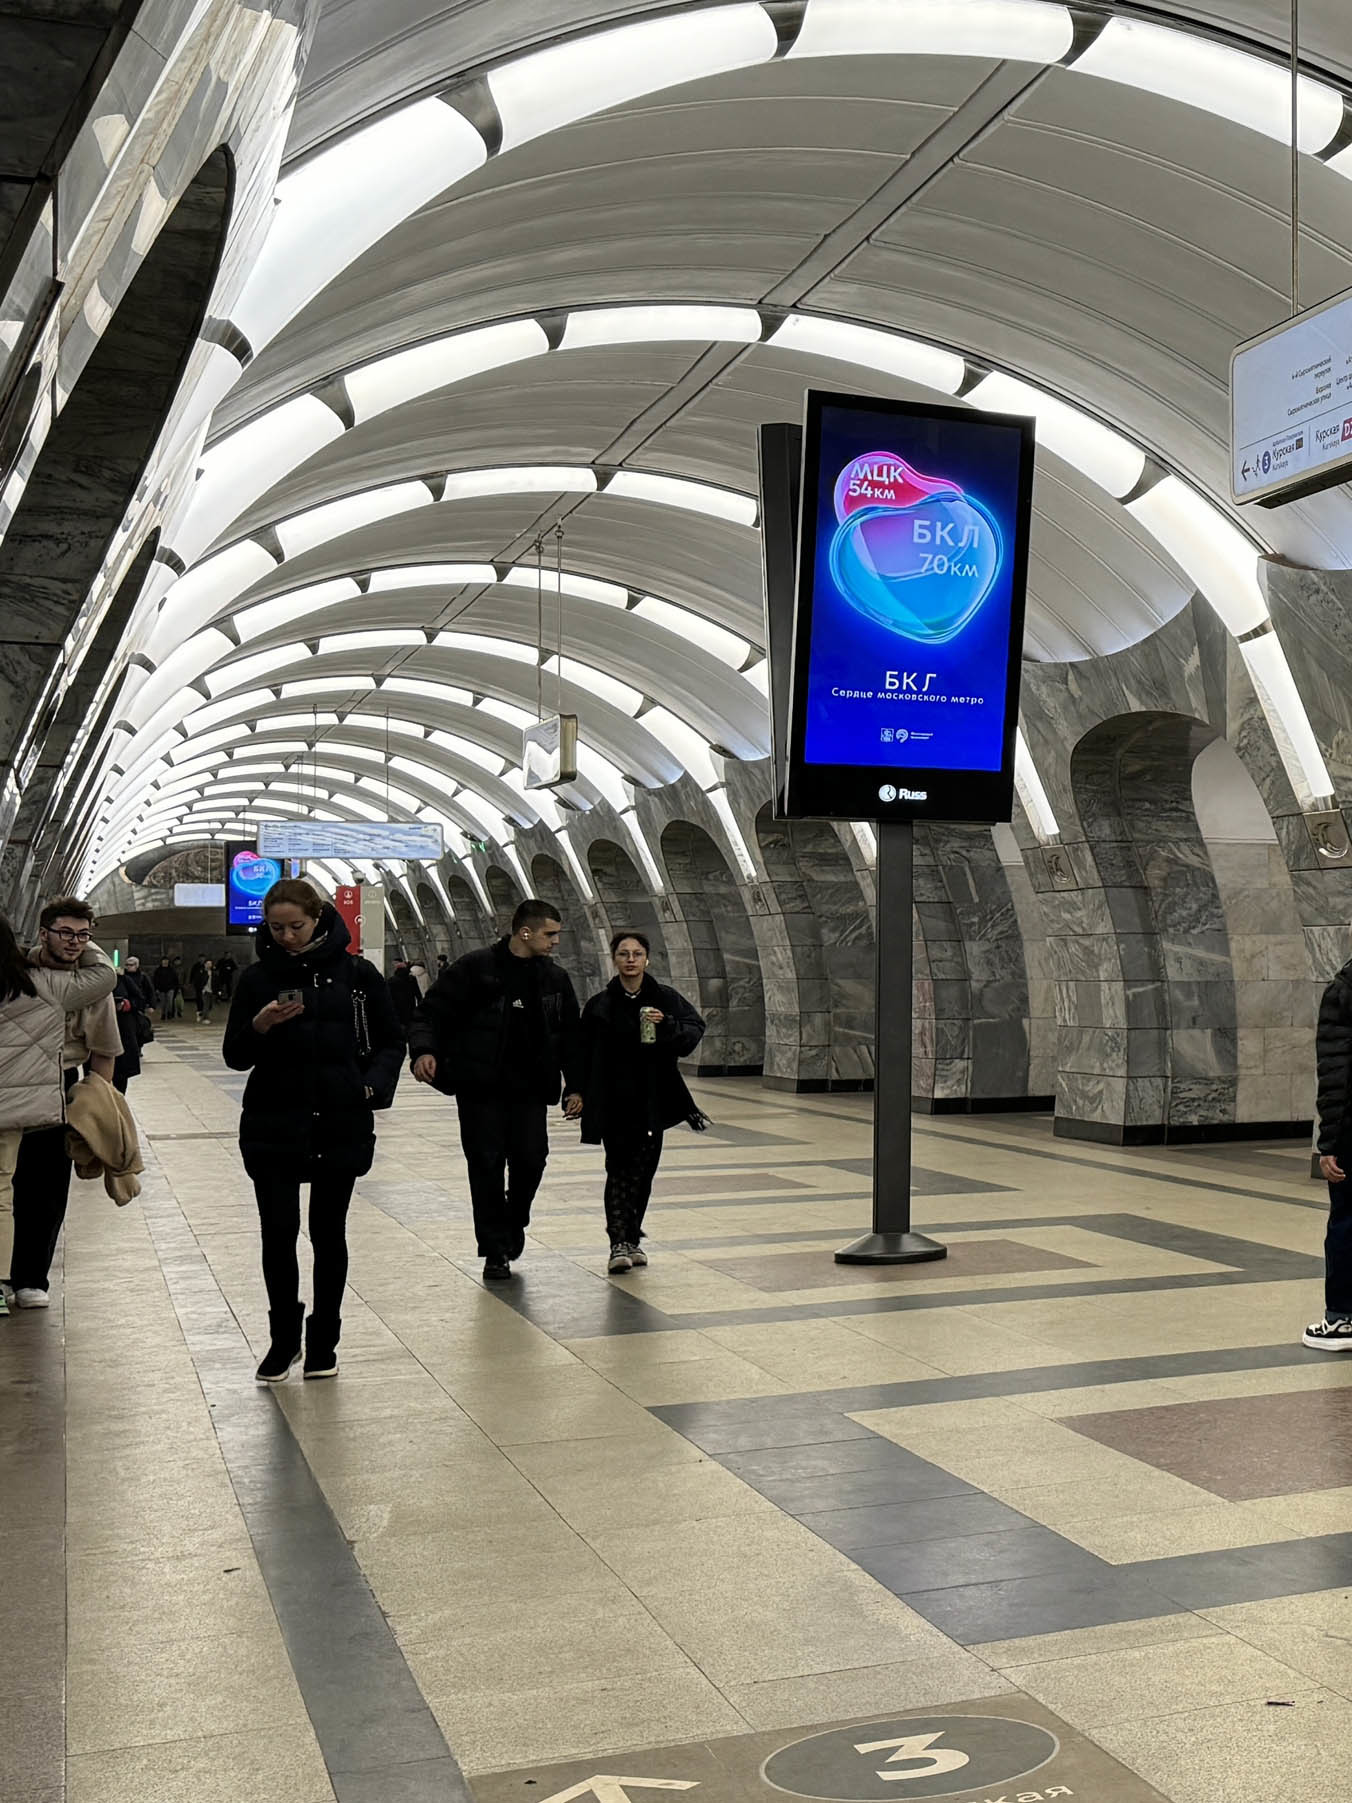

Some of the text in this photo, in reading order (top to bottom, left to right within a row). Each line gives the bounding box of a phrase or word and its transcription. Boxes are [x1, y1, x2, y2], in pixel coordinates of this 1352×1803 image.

[1315, 425, 1340, 442] Курская
[1272, 443, 1295, 461] Курская
[850, 462, 904, 485] МЦК
[912, 519, 980, 549] БКЛ
[831, 687, 984, 705] Сердце московского метро
[898, 788, 928, 801] Russ
[853, 1730, 970, 1782] 3
